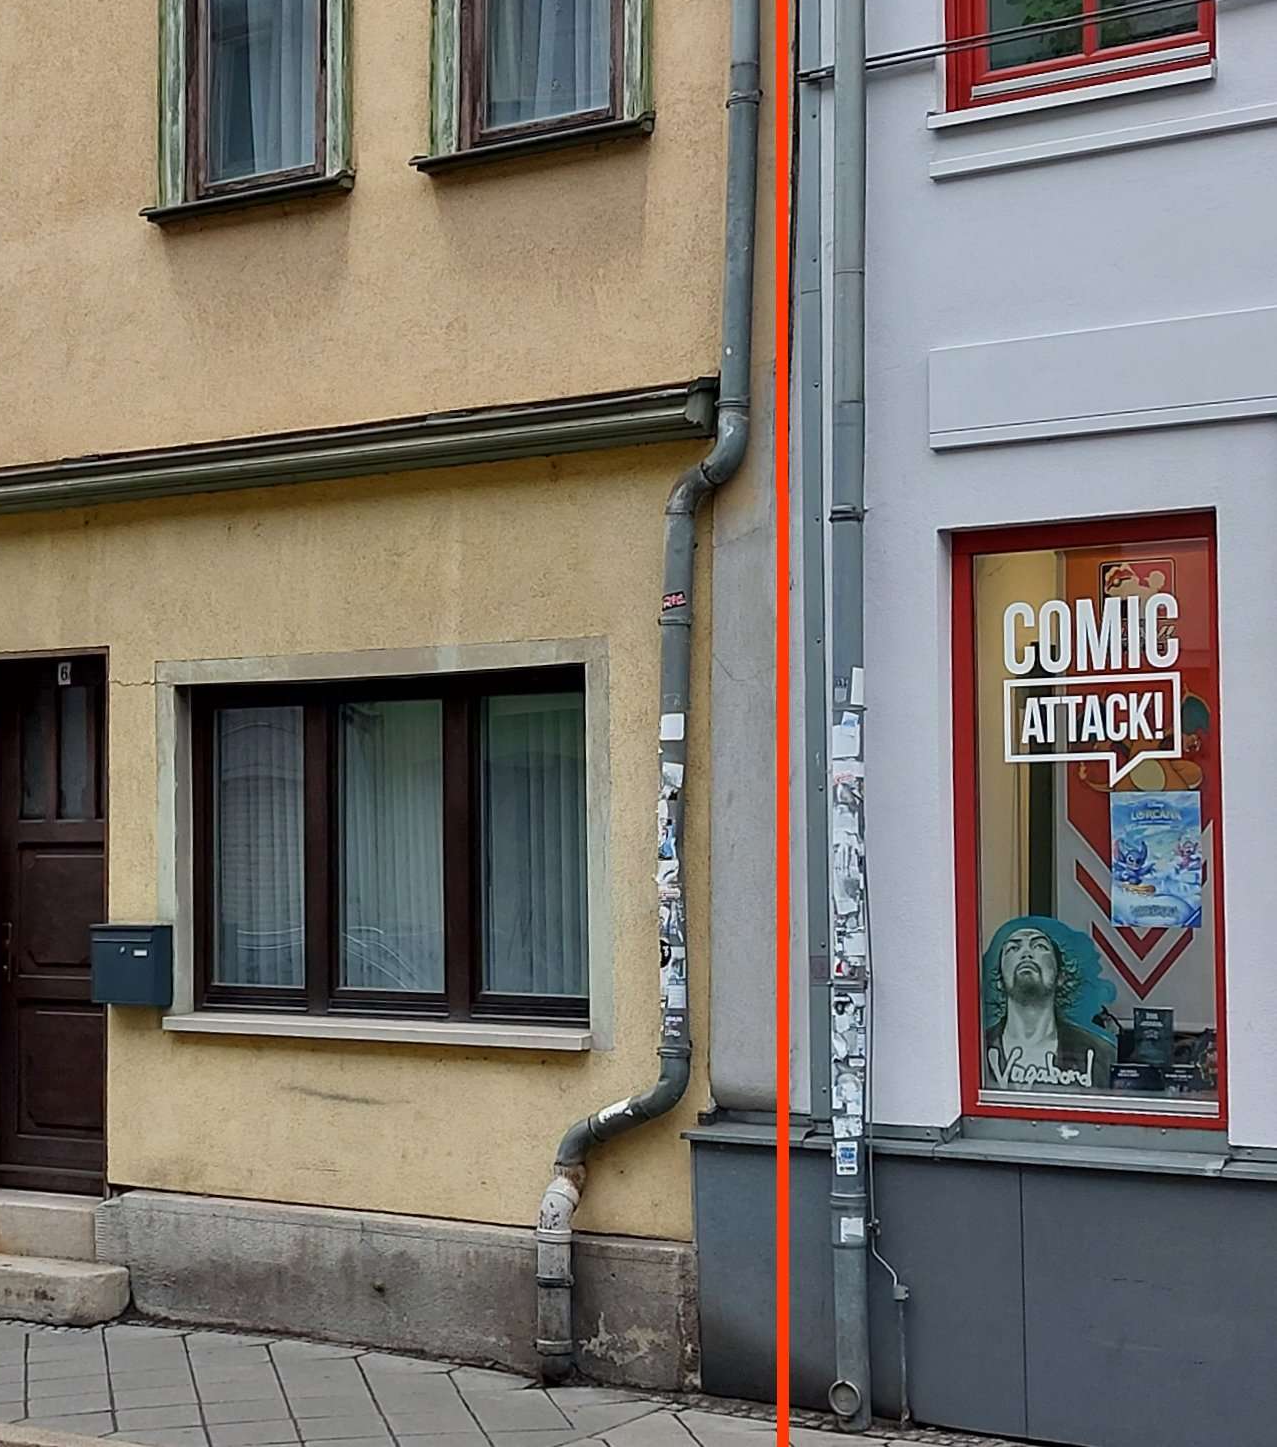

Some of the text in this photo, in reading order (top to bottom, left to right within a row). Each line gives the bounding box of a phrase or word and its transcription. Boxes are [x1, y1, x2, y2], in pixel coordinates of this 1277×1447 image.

[1003, 593, 1180, 675] COMIC
[1022, 692, 1165, 744] ATTACK!
[987, 1048, 1094, 1090] Vagabond
